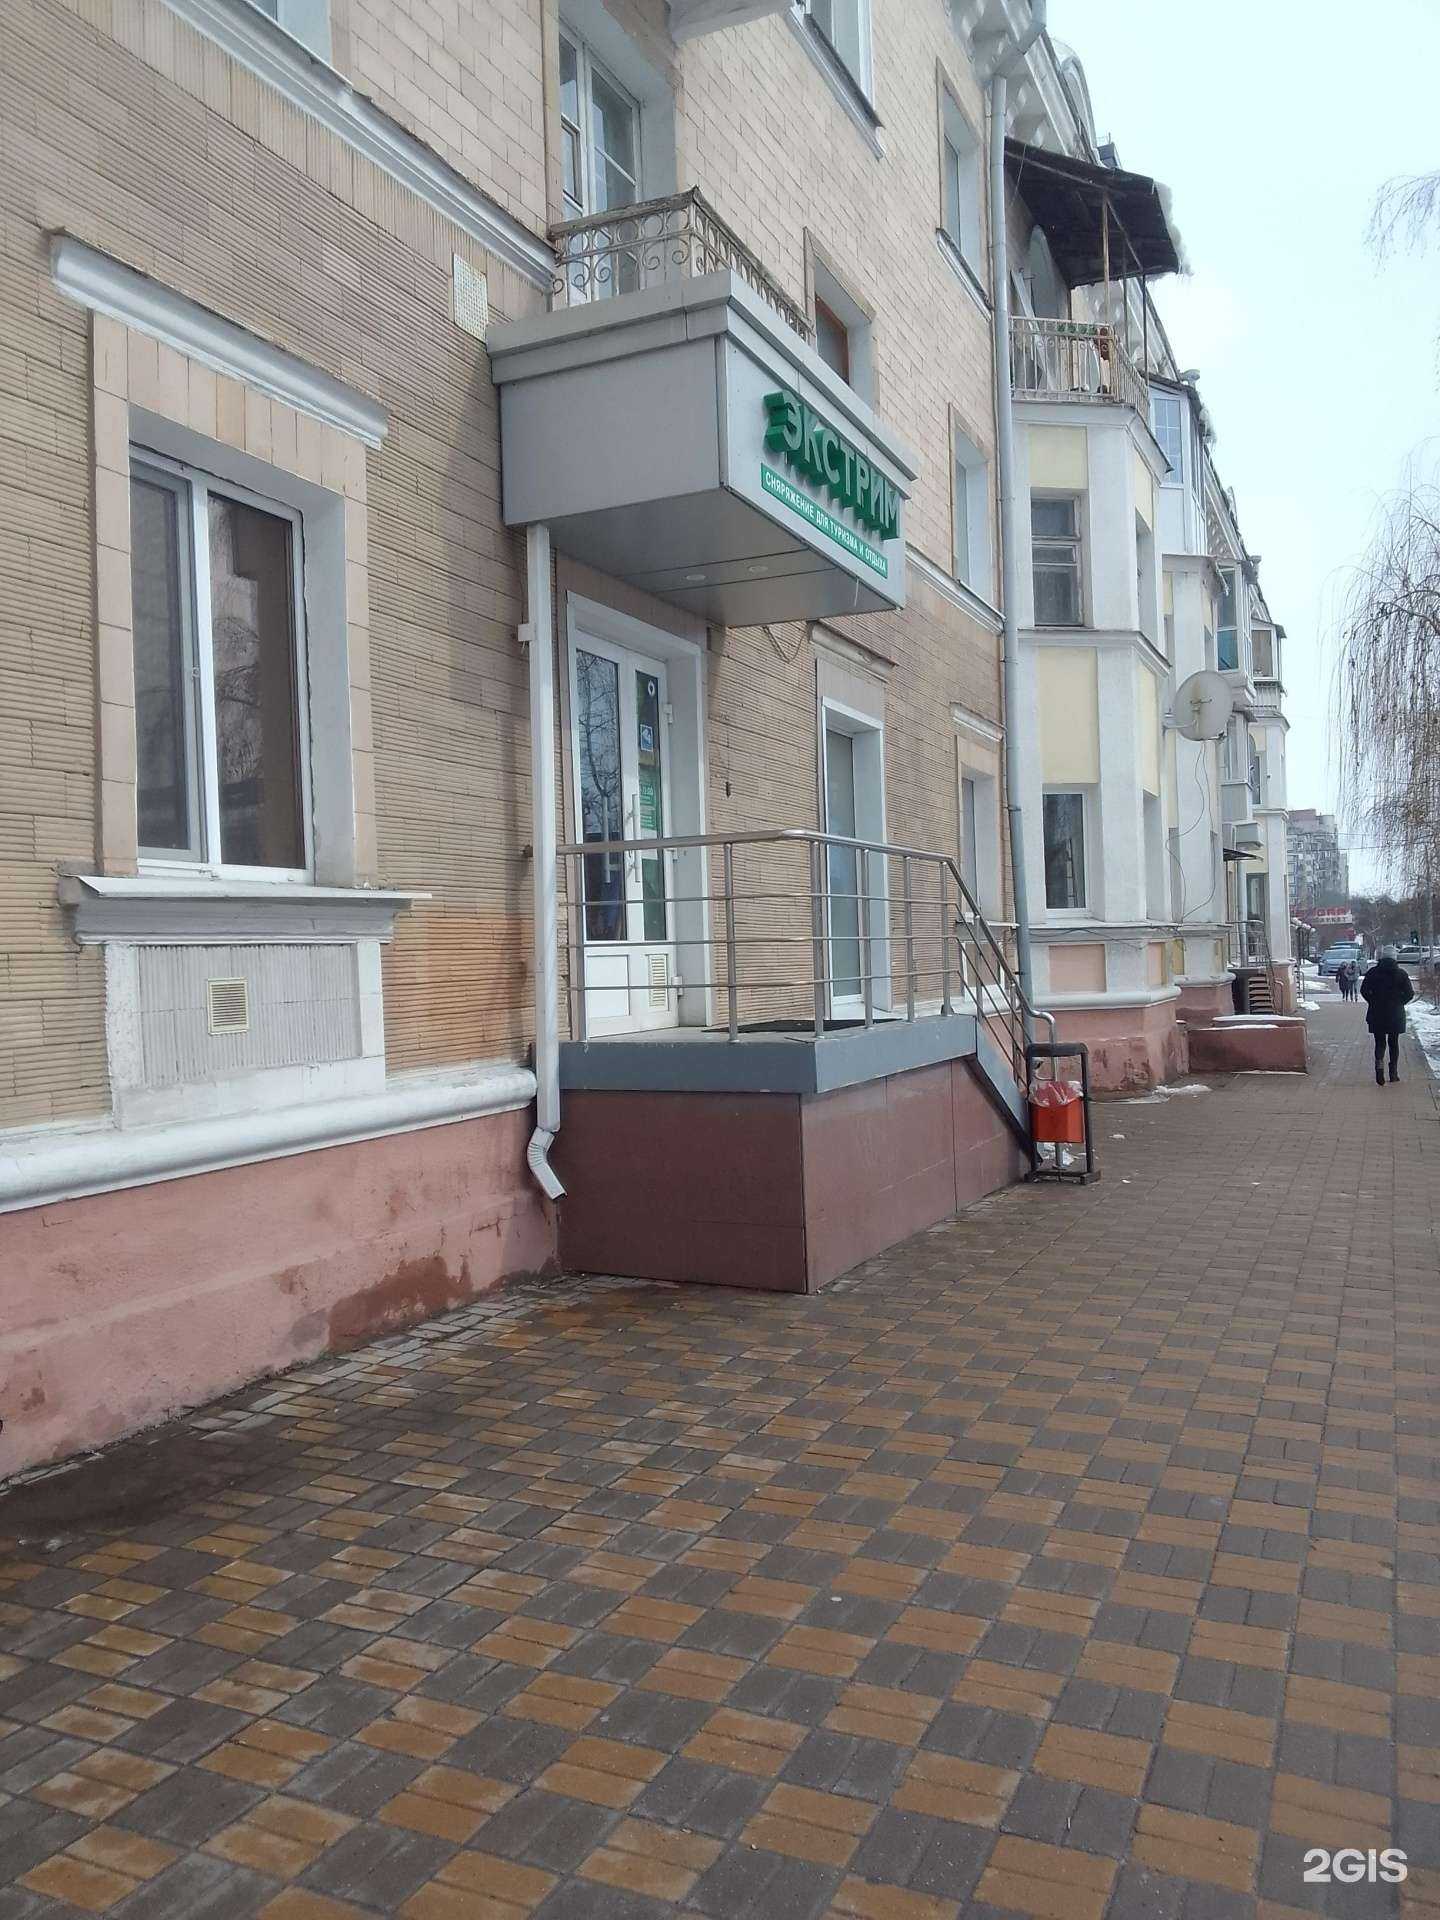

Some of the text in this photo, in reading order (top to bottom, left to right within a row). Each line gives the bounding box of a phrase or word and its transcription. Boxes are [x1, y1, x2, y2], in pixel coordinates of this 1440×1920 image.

[764, 391, 900, 540] ЭКСТРИМ
[816, 510, 829, 530] ДЛЯ
[829, 520, 858, 552] ТУРИЗМА
[865, 547, 886, 572] ОТДЫХА
